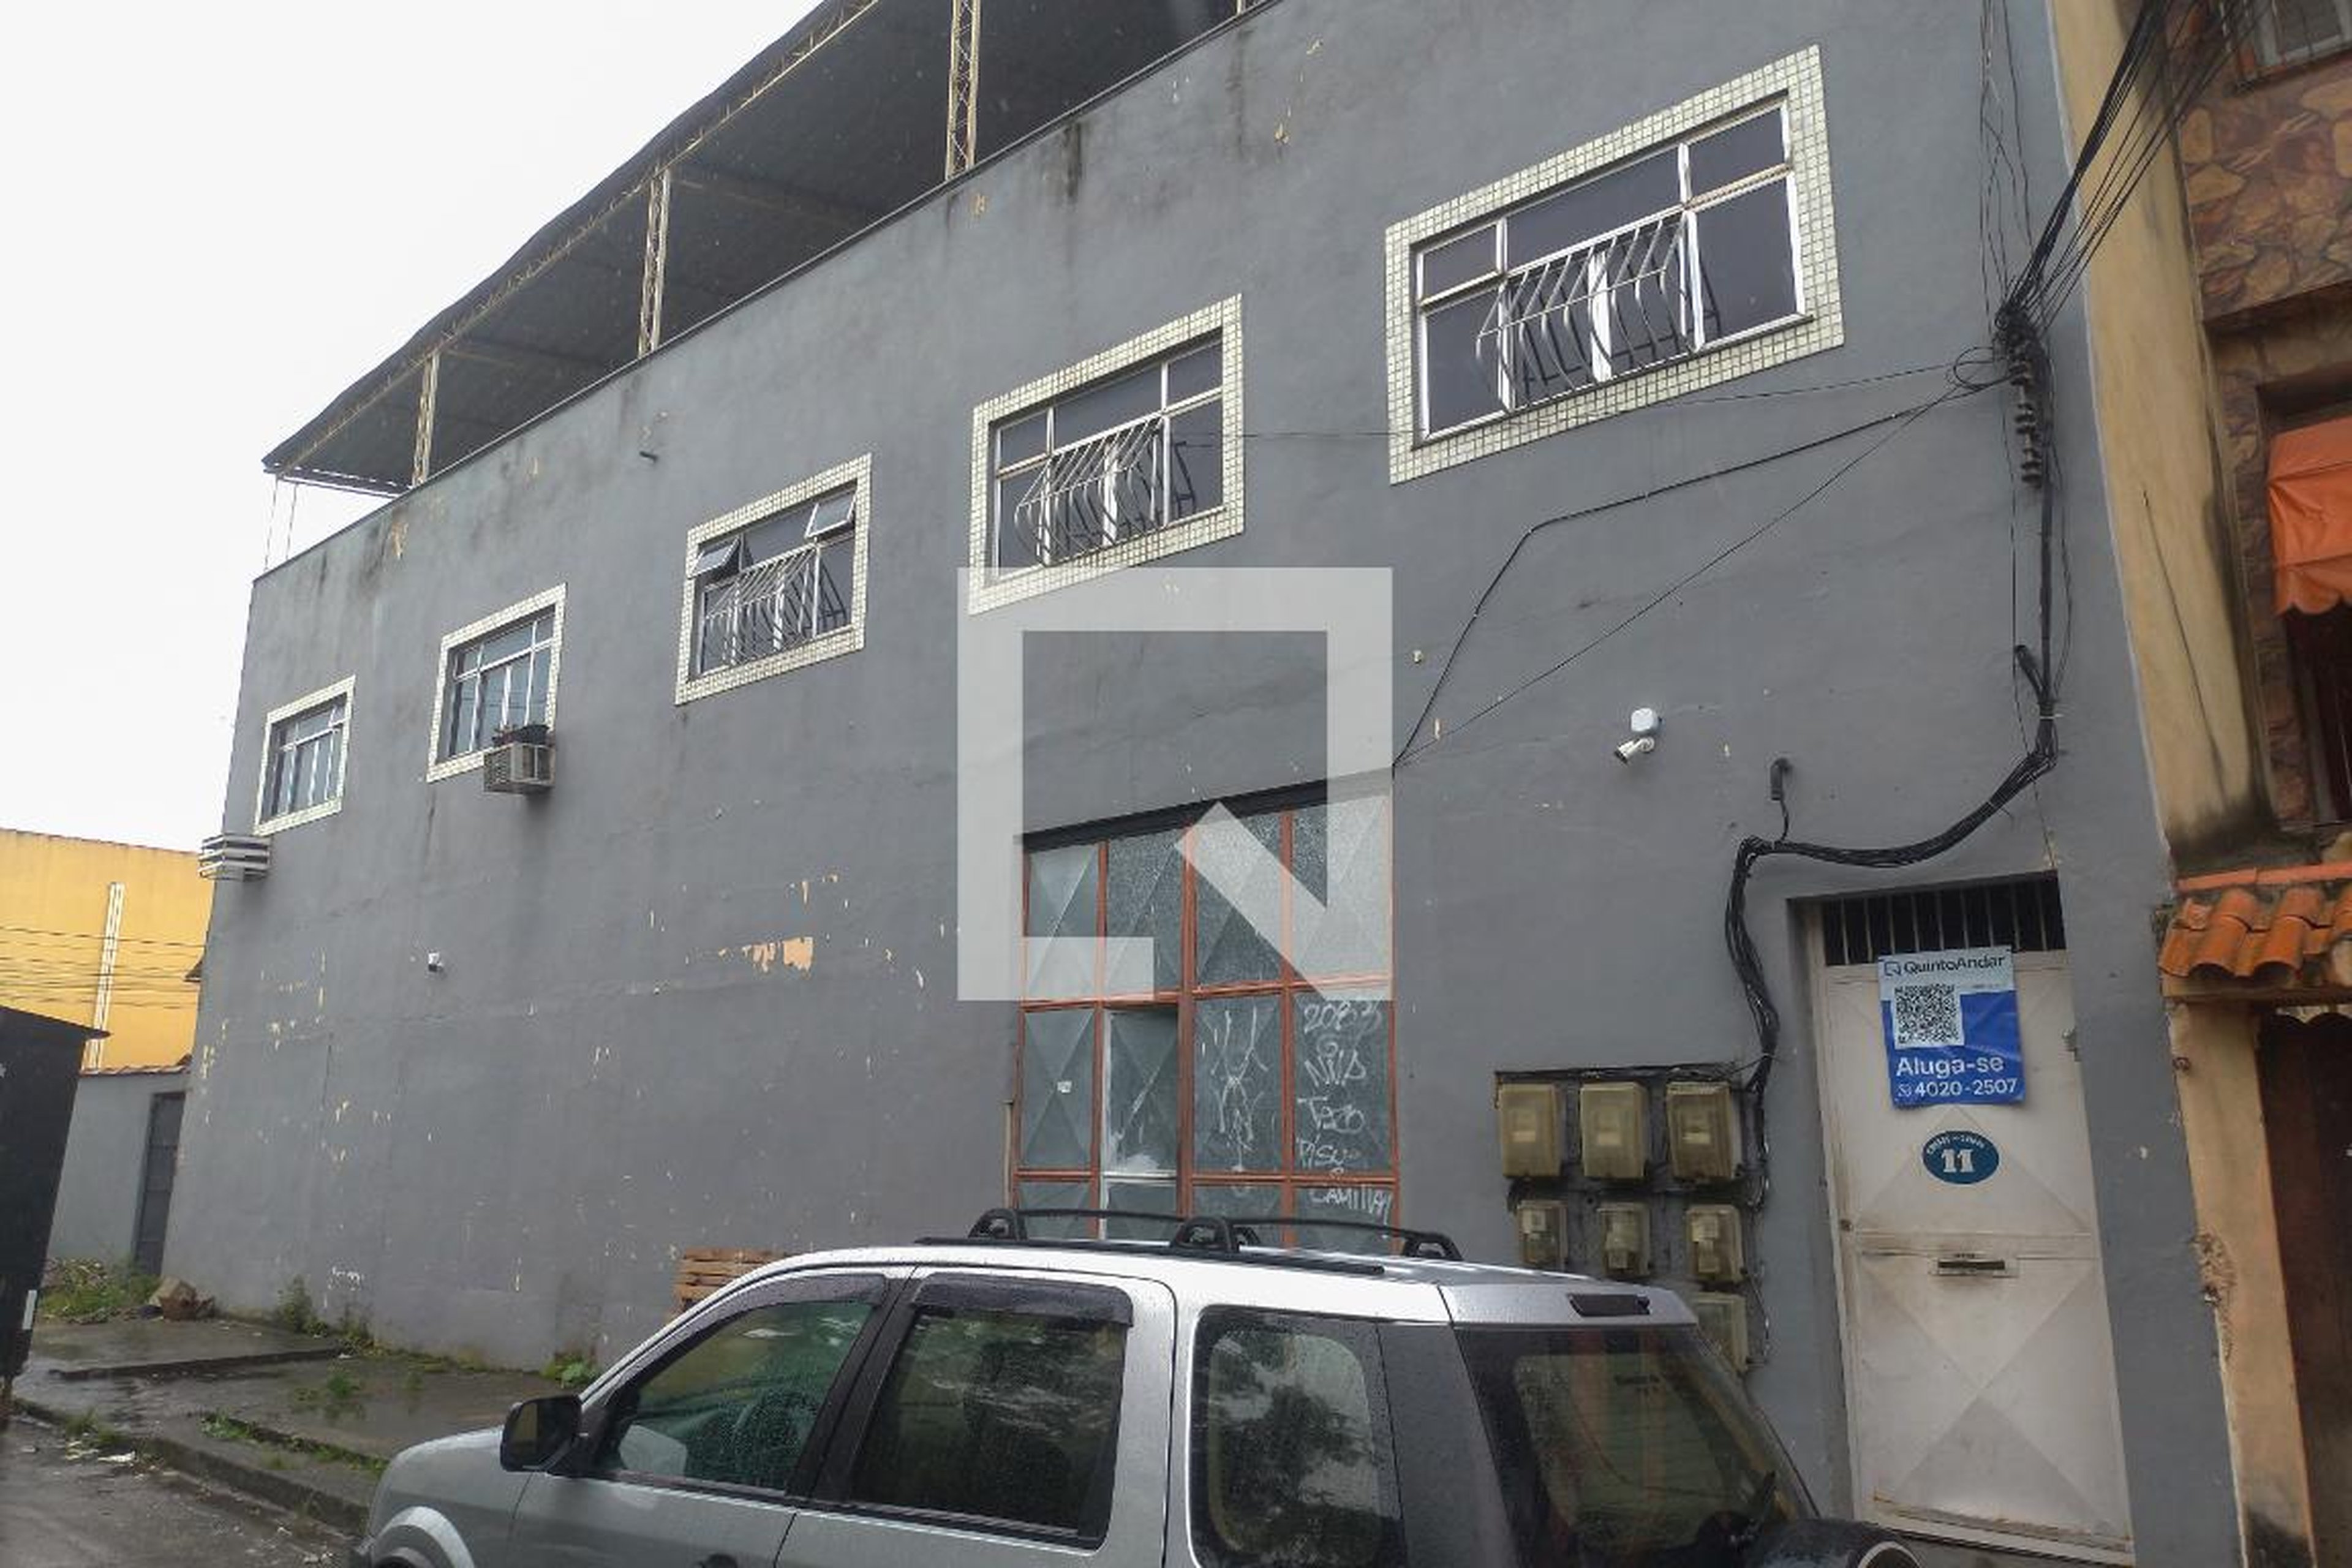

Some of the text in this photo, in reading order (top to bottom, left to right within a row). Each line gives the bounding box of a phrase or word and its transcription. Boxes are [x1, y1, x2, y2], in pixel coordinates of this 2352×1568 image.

[1904, 954, 2005, 974] QuintoAndar
[1896, 1056, 2004, 1079] Aluga-se
[1941, 1149, 1975, 1173] 11
